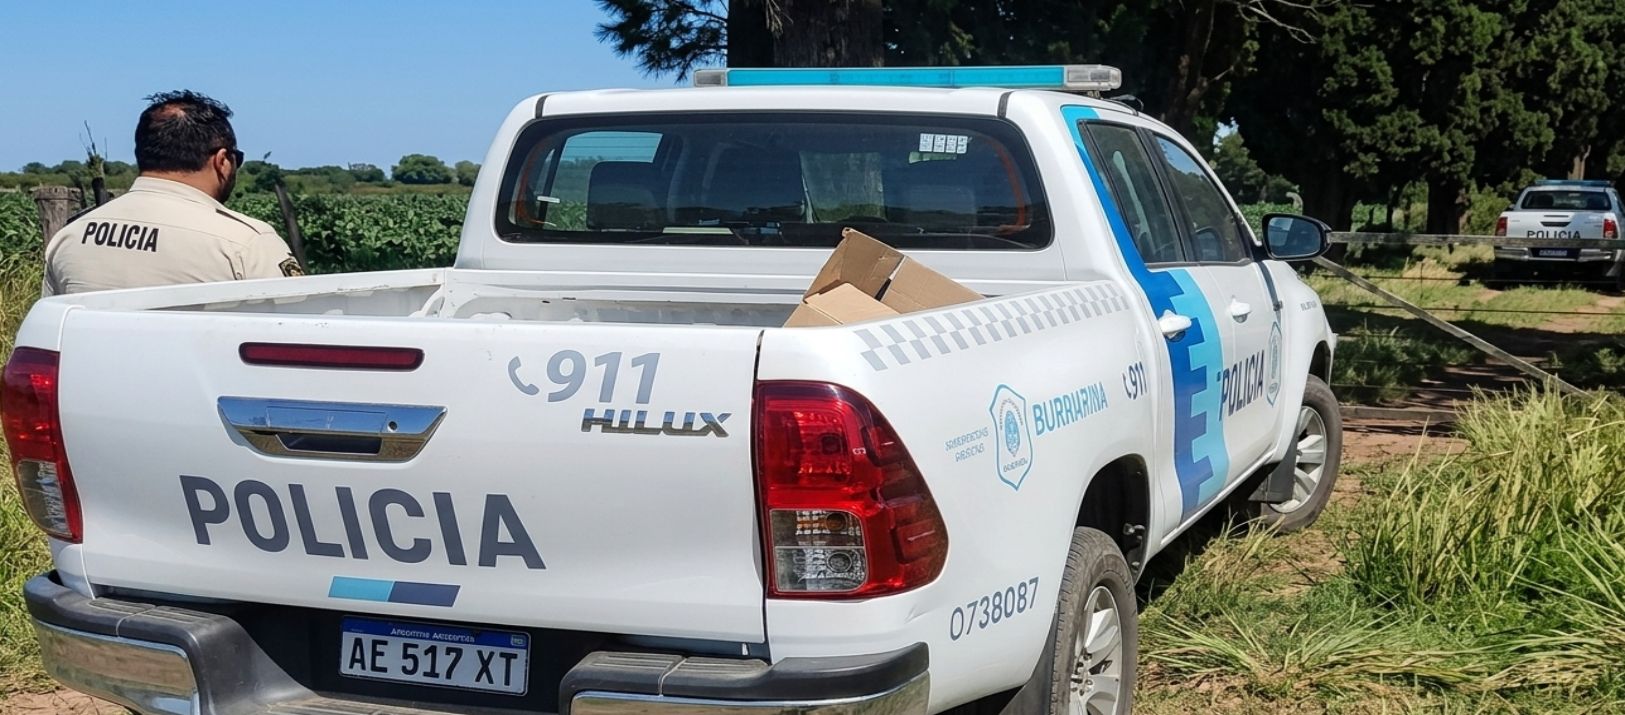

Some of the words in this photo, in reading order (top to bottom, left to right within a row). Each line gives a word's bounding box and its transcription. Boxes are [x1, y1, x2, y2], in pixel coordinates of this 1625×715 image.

[82, 221, 160, 252] POLICIA
[546, 349, 661, 405] 911
[1128, 361, 1147, 400] 911
[1218, 349, 1265, 421] POLICIA
[581, 408, 732, 438] HILUX
[179, 474, 547, 570] POLICIA
[348, 637, 389, 674] AE
[401, 642, 464, 680] 517
[474, 649, 518, 687] XT
